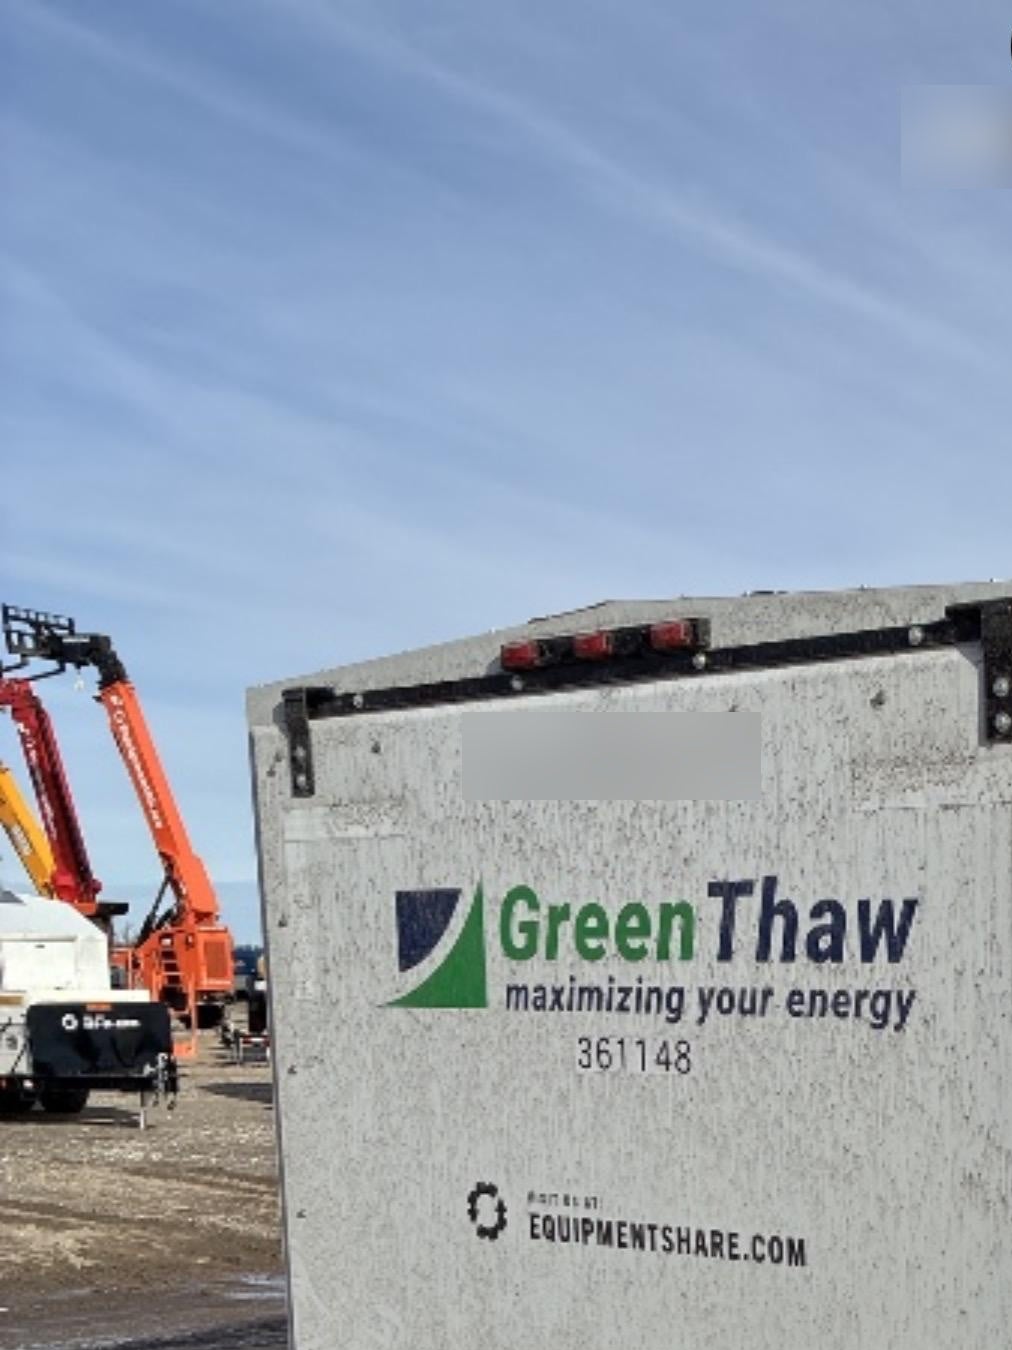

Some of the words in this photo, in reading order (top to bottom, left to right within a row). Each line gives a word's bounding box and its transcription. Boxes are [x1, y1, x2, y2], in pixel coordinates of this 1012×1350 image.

[505, 977, 686, 1023] maximizing
[696, 986, 774, 1026] your
[786, 987, 916, 1032] energy
[577, 1037, 692, 1074] 361148
[528, 1212, 807, 1268] EQUIPMENTSHARE.COM
